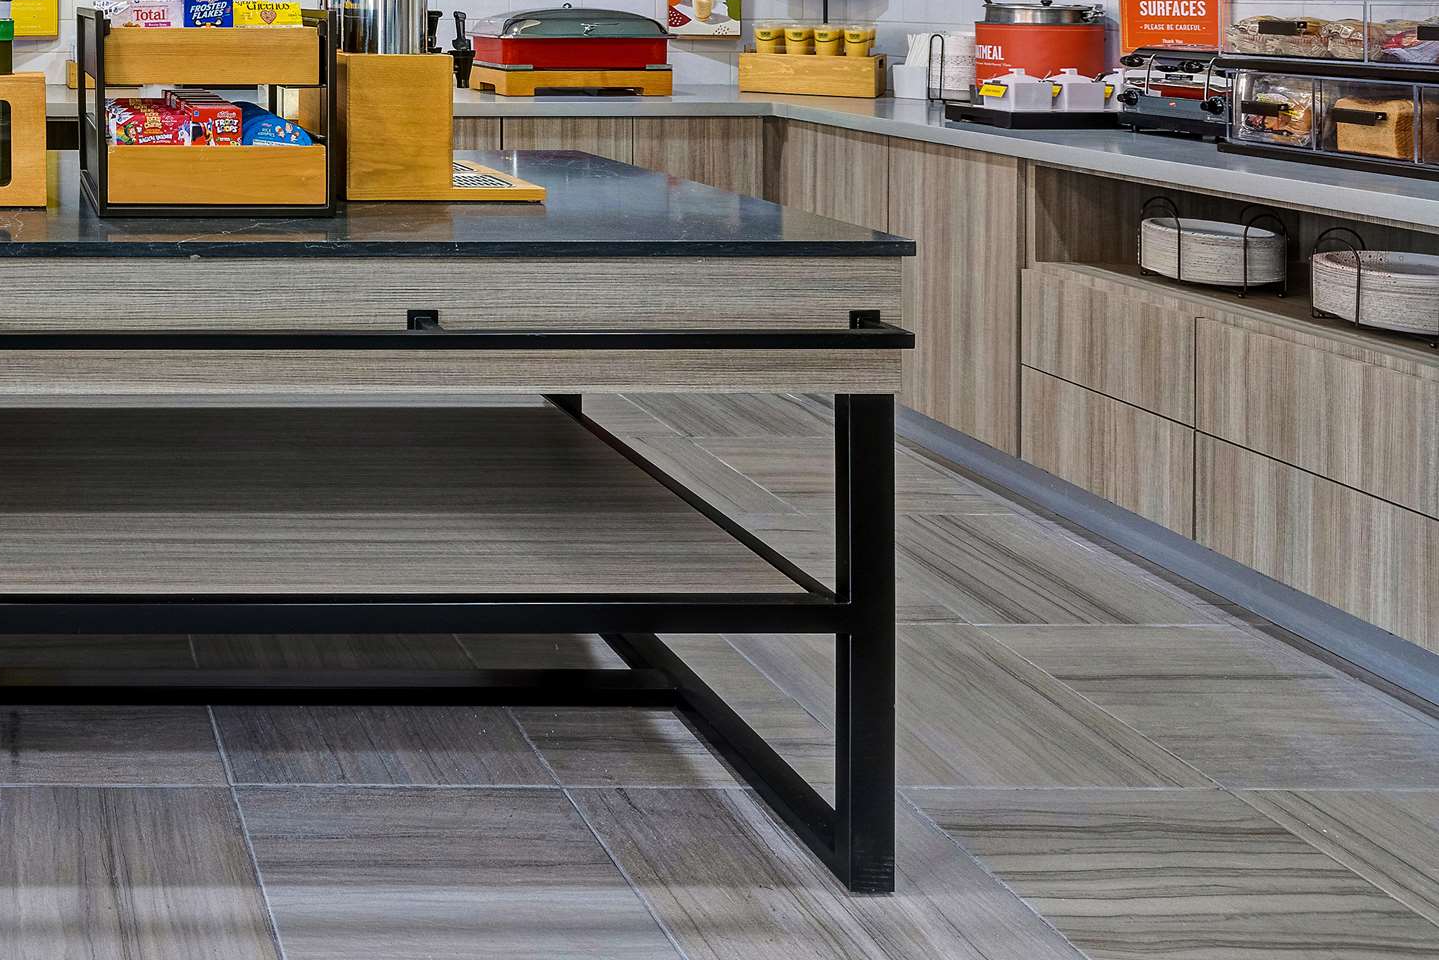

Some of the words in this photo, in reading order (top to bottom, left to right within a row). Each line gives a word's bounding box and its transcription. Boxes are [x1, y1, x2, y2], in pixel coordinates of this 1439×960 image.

[190, 1, 227, 13] FROSTED
[1139, 0, 1206, 17] SURFACES
[133, 9, 166, 21] Total
[192, 9, 224, 20] FLAKES
[1143, 23, 1165, 31] PLEASE
[215, 118, 239, 127] FROOT
[216, 125, 238, 134] LOOPS
